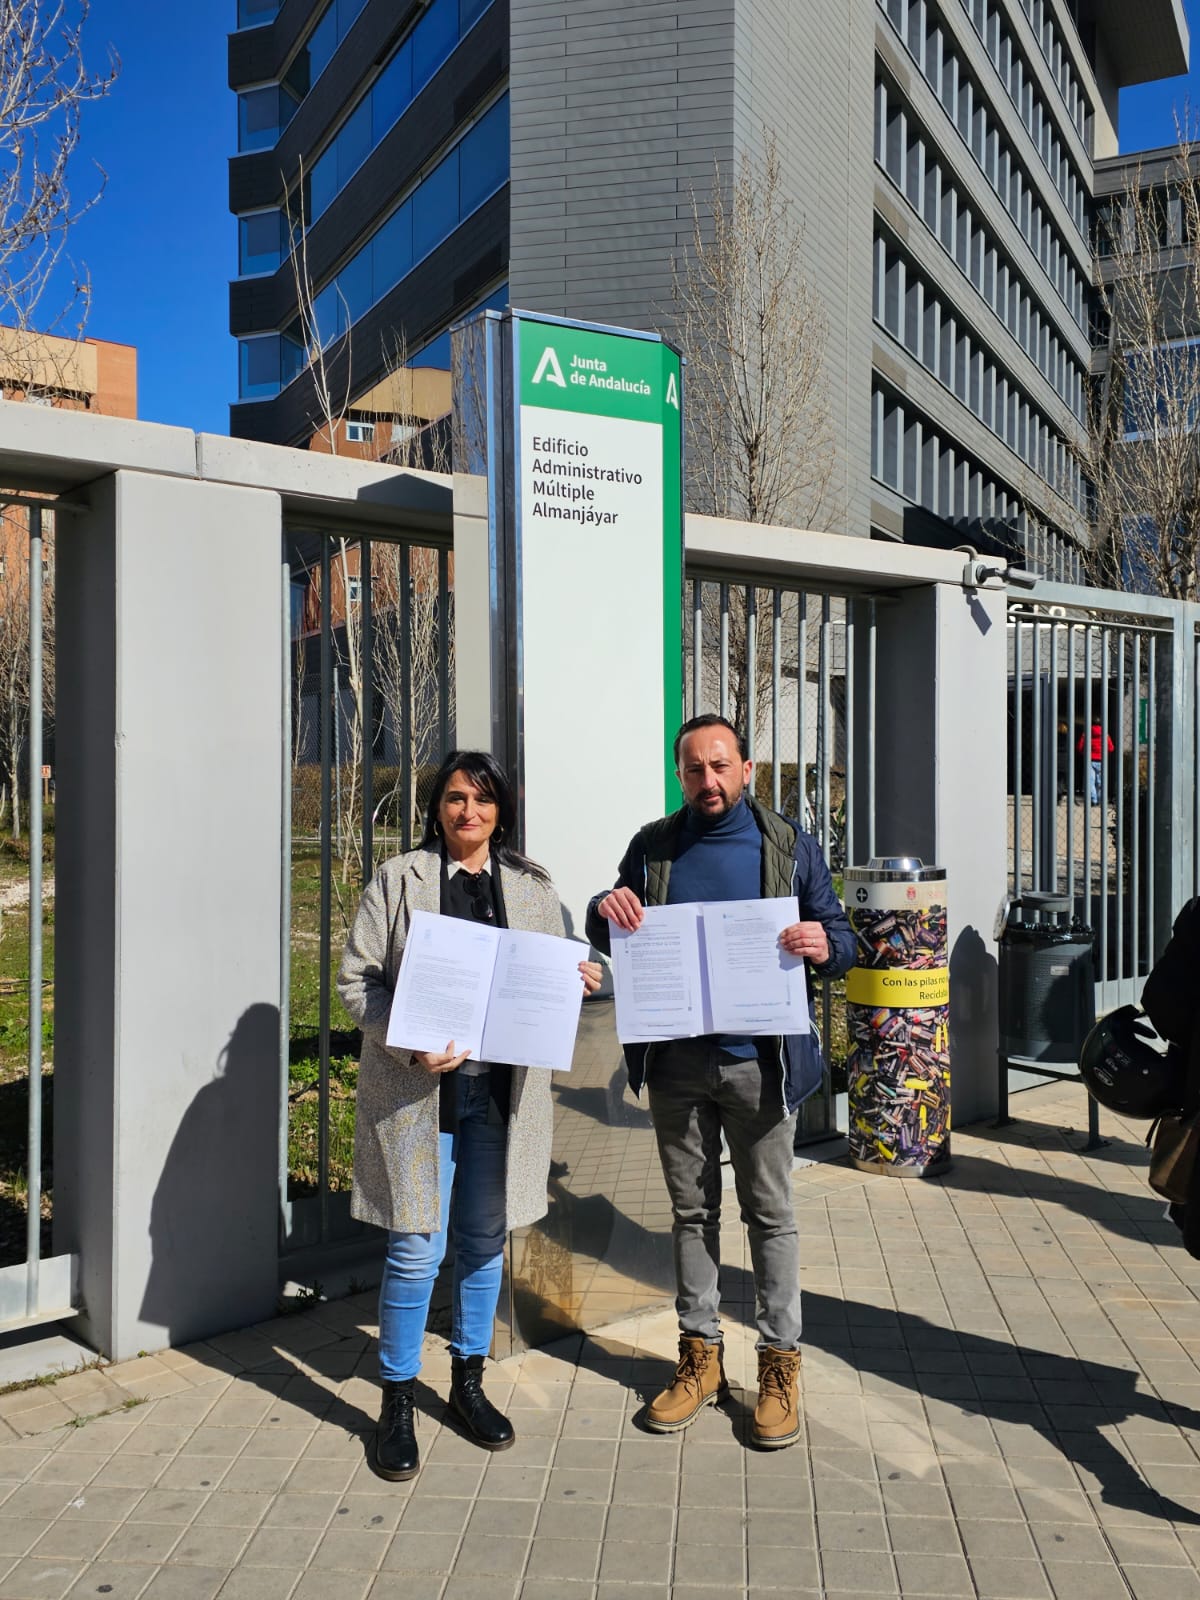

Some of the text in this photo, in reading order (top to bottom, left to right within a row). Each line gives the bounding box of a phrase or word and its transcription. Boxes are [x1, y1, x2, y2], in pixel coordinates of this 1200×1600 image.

[570, 354, 607, 372] Junta
[570, 371, 651, 396] de Andalucía
[532, 436, 589, 457] Edificio
[532, 458, 643, 485] Administrativo
[532, 480, 595, 503] Múltiple
[532, 502, 619, 527] Almanjáyar
[882, 976, 902, 987] Con
[904, 976, 918, 987] las
[920, 976, 938, 988] pilas
